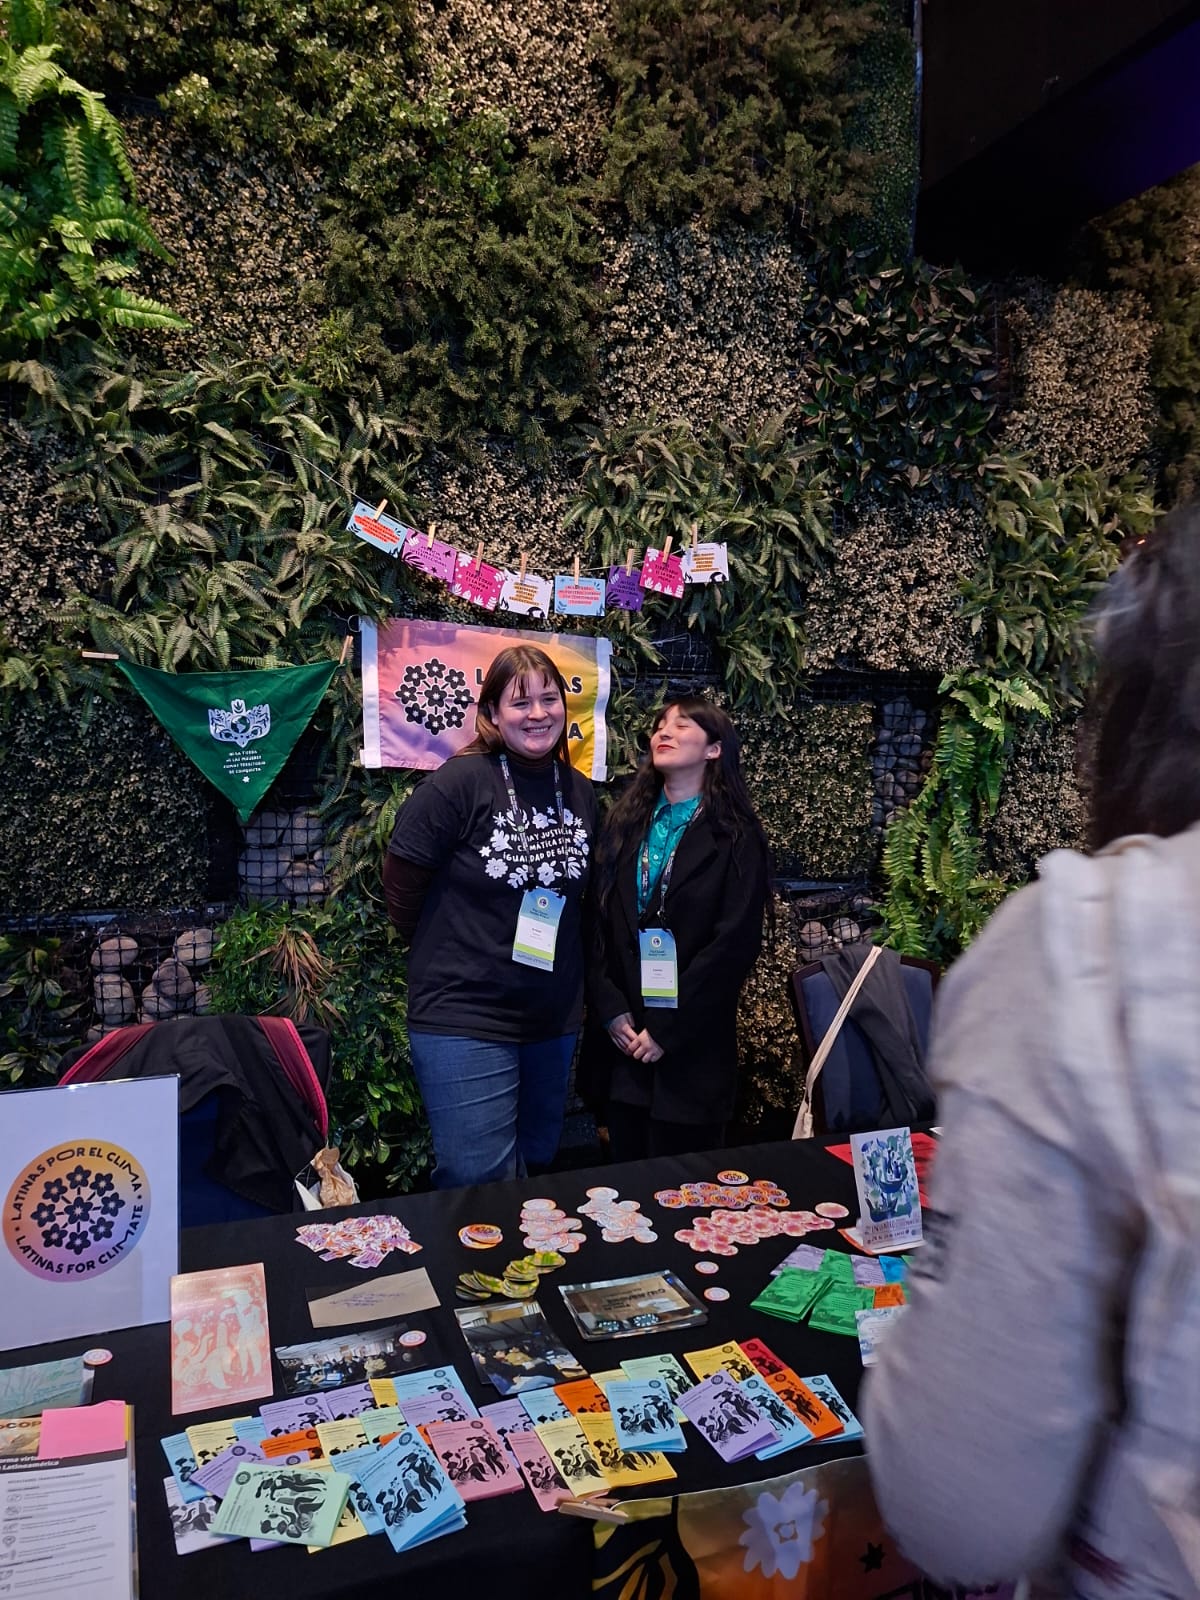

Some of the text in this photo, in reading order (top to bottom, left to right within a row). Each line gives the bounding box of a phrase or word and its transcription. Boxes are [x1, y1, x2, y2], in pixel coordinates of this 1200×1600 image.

[517, 839, 557, 851] CMÁTICA
[546, 849, 556, 858] DE
[11, 1147, 142, 1221] LATINAS POR EL CLIMA
[16, 1204, 144, 1274] LATINAS FOR CLIMATE
